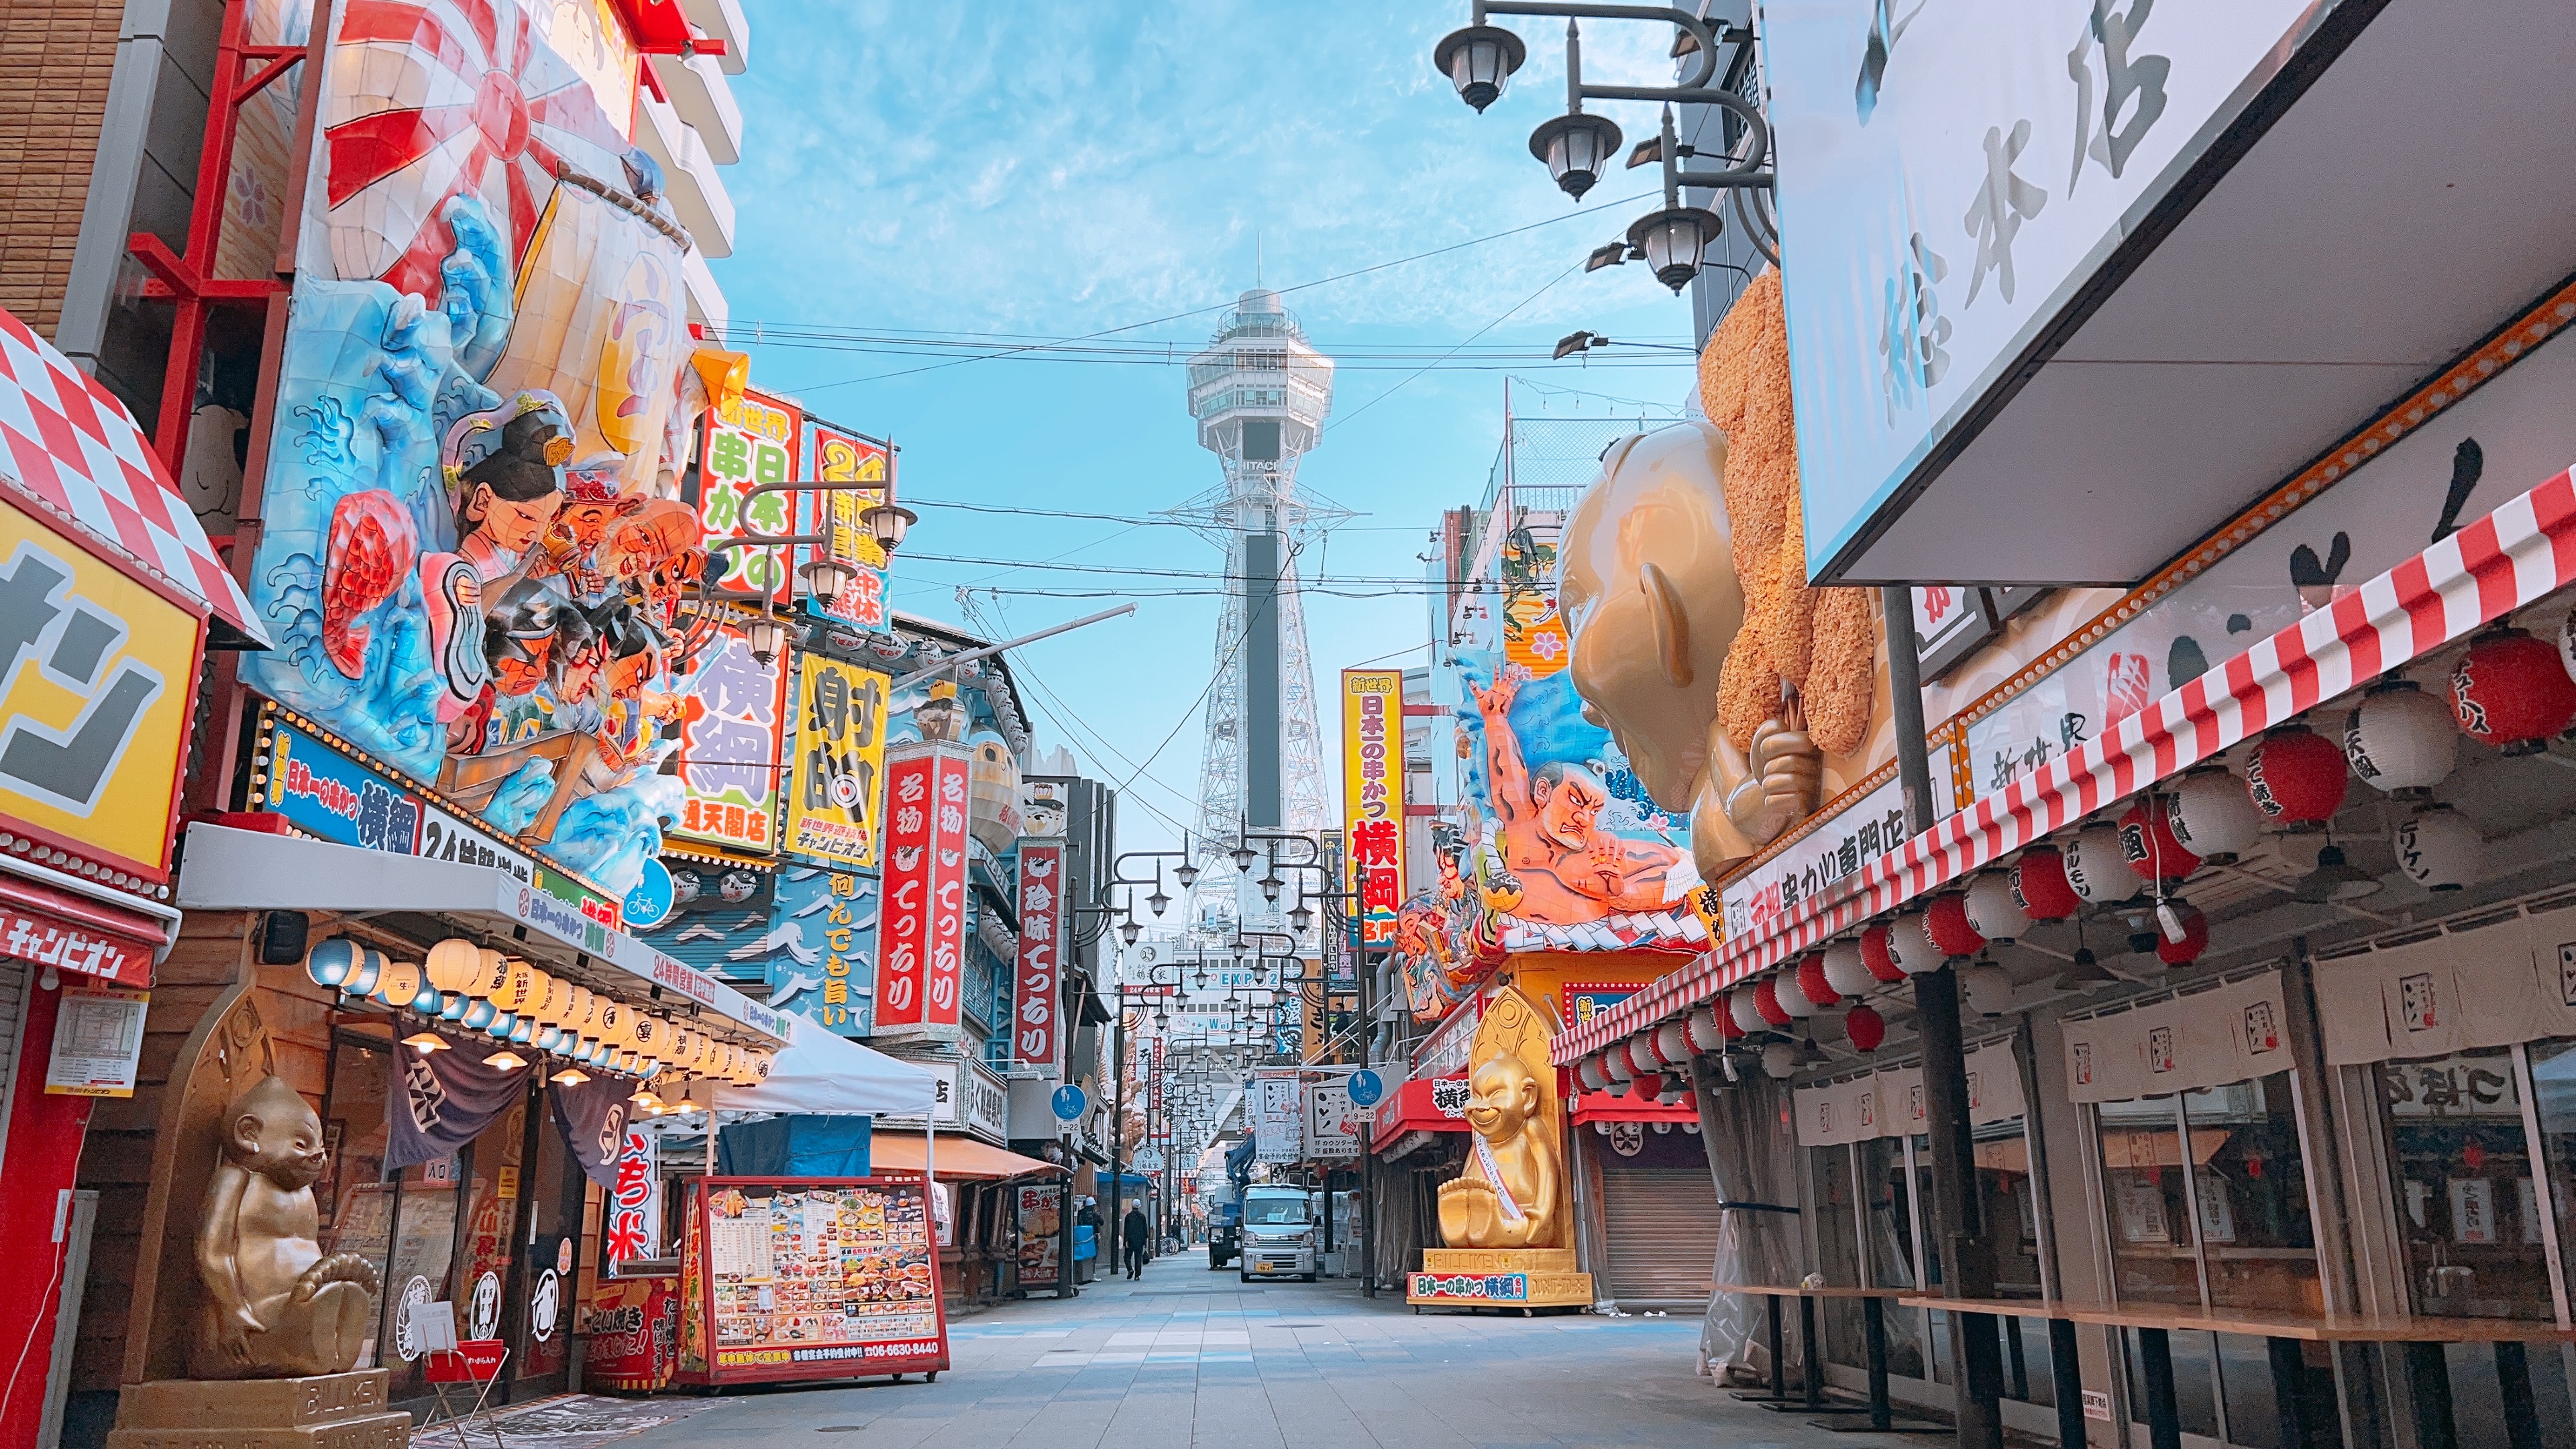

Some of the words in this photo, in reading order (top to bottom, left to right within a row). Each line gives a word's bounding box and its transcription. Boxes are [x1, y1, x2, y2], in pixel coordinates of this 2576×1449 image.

[1241, 461, 1281, 471] HITACH
[745, 443, 786, 590] 日本の
[1350, 678, 1393, 693] 新世界
[802, 666, 883, 824] 射的
[1360, 696, 1387, 818] 日本一の串かつ
[683, 802, 767, 844] 通天閣店
[796, 832, 869, 861] チャンピオン
[1351, 820, 1399, 914] 横綱
[7, 919, 125, 979] チャンピオン
[822, 873, 855, 1026] 何んでも旨い
[1020, 883, 1054, 1057] 珍味てっちり
[1417, 1276, 1484, 1297] 日本一の串かつ
[1485, 1276, 1514, 1298] 横綱
[1434, 1253, 1501, 1270] BILLIKEN
[871, 1342, 938, 1358] 06-6630-8440
